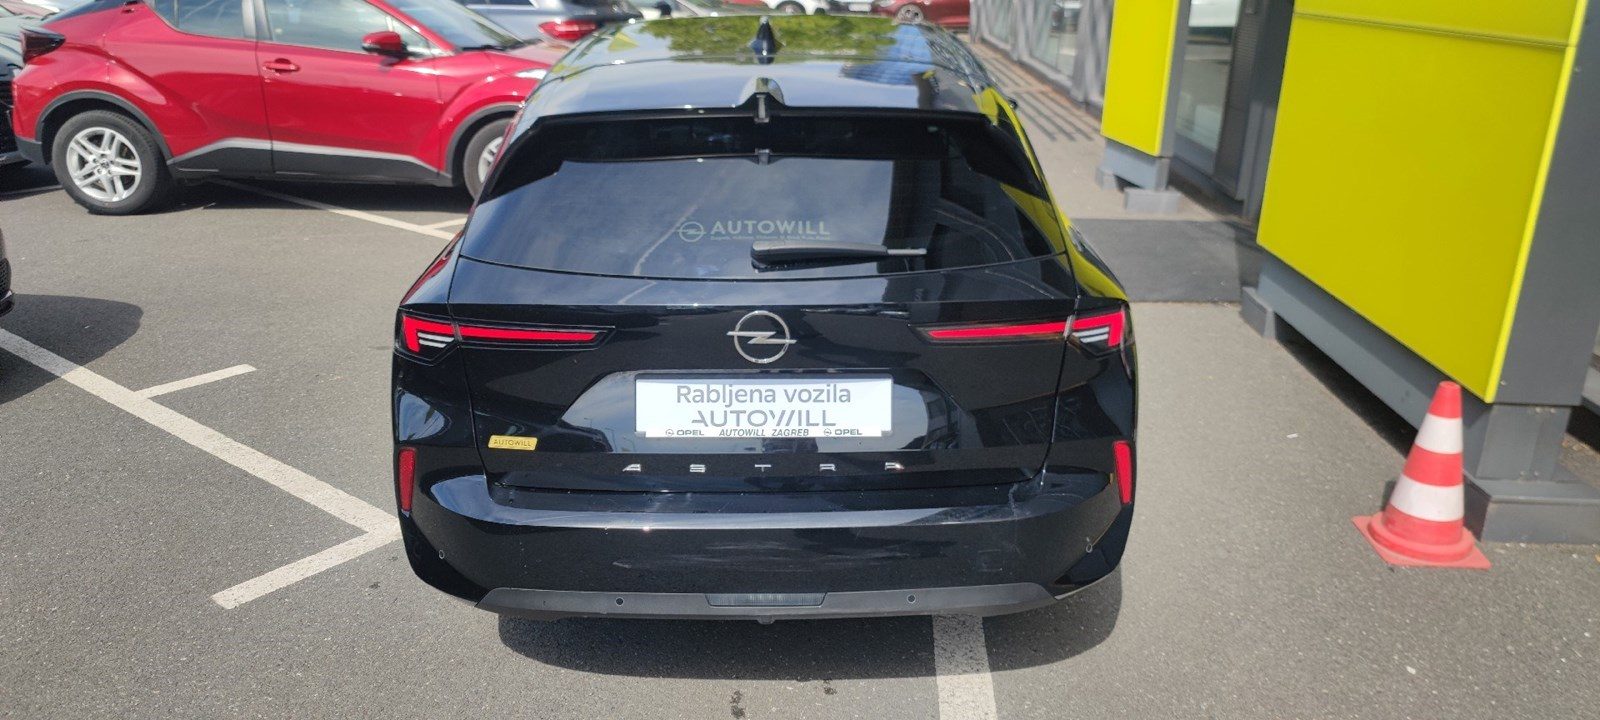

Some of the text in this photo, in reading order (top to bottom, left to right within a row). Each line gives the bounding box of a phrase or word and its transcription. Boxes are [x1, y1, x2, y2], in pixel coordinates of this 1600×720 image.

[710, 220, 831, 235] AUTOWILL
[676, 384, 852, 408] Rabljena vozila
[691, 409, 837, 428] AUTOWILL
[718, 428, 810, 437] AUTOWILL ZAGREB
[493, 438, 532, 447] AUTOWILL
[622, 461, 905, 473] ASTRA
